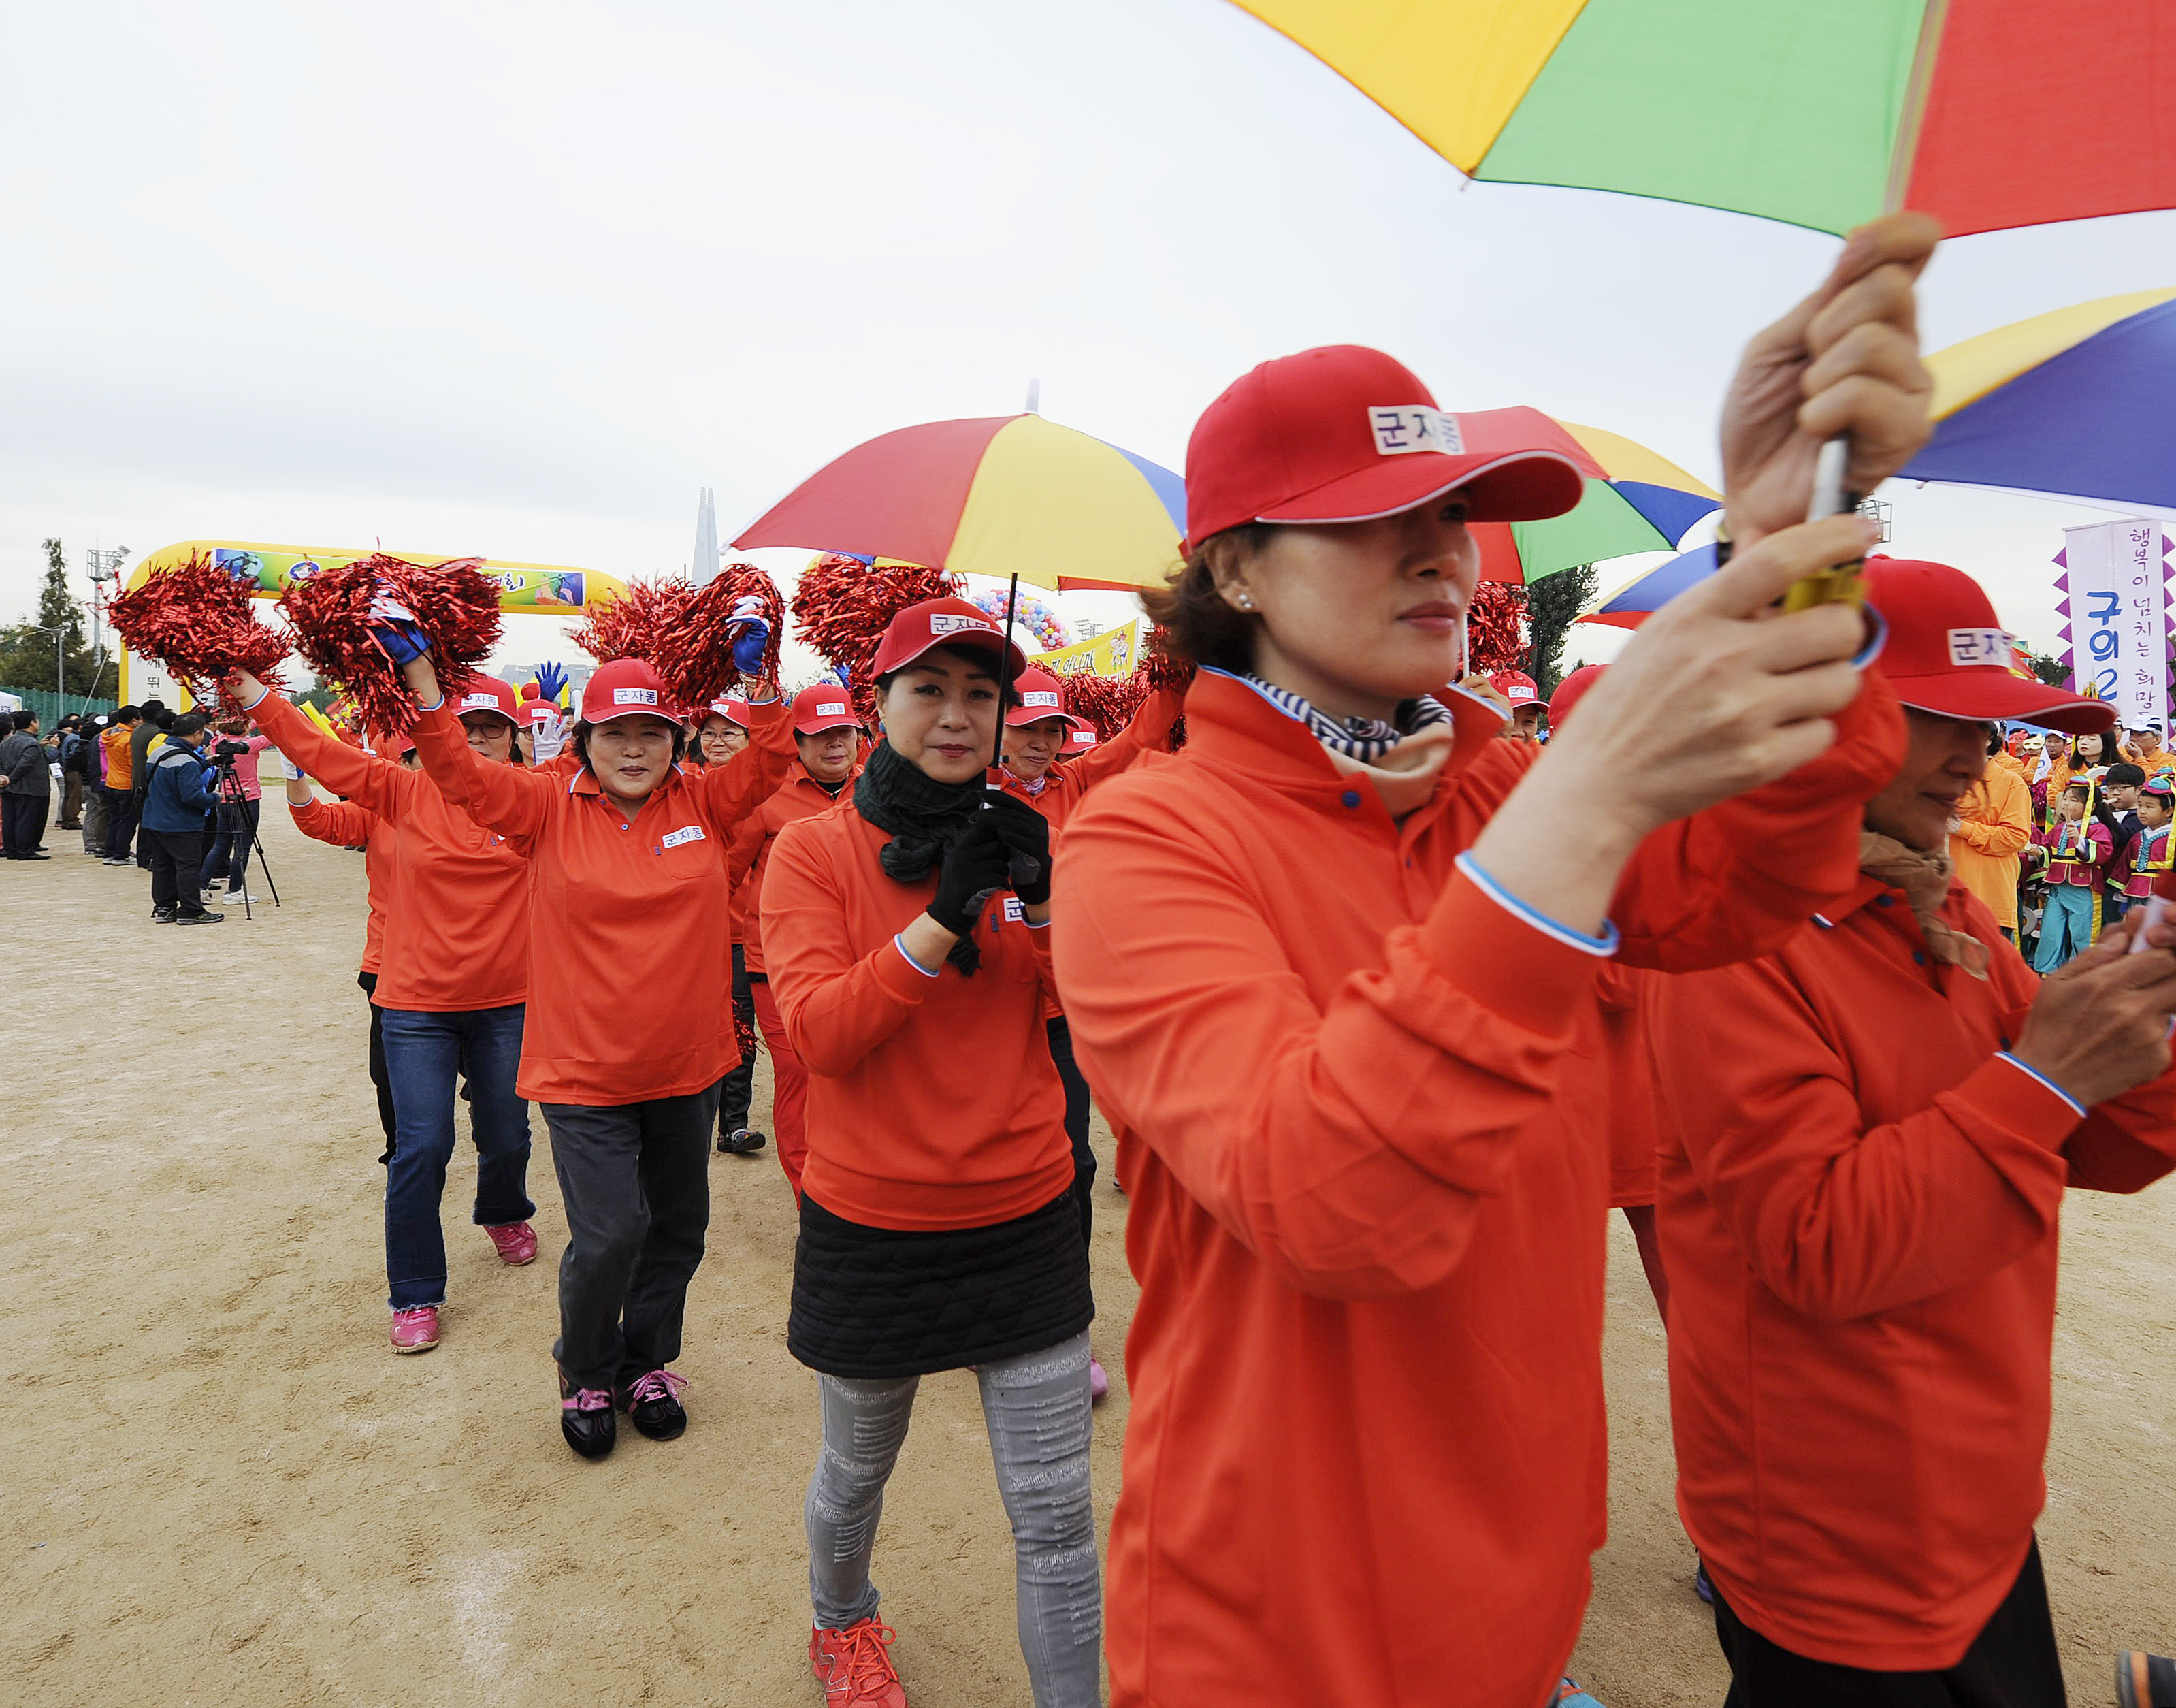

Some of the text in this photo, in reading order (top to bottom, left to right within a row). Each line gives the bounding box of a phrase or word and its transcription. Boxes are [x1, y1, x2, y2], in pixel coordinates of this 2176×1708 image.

[2129, 528, 2151, 587] 행복이
[2133, 597, 2153, 658] 넘치는
[615, 690, 657, 704] 군자동
[1025, 692, 1057, 705] 군자동
[2134, 668, 2158, 715] 희망
[817, 704, 844, 714] 군자동
[665, 827, 702, 846] 군자동
